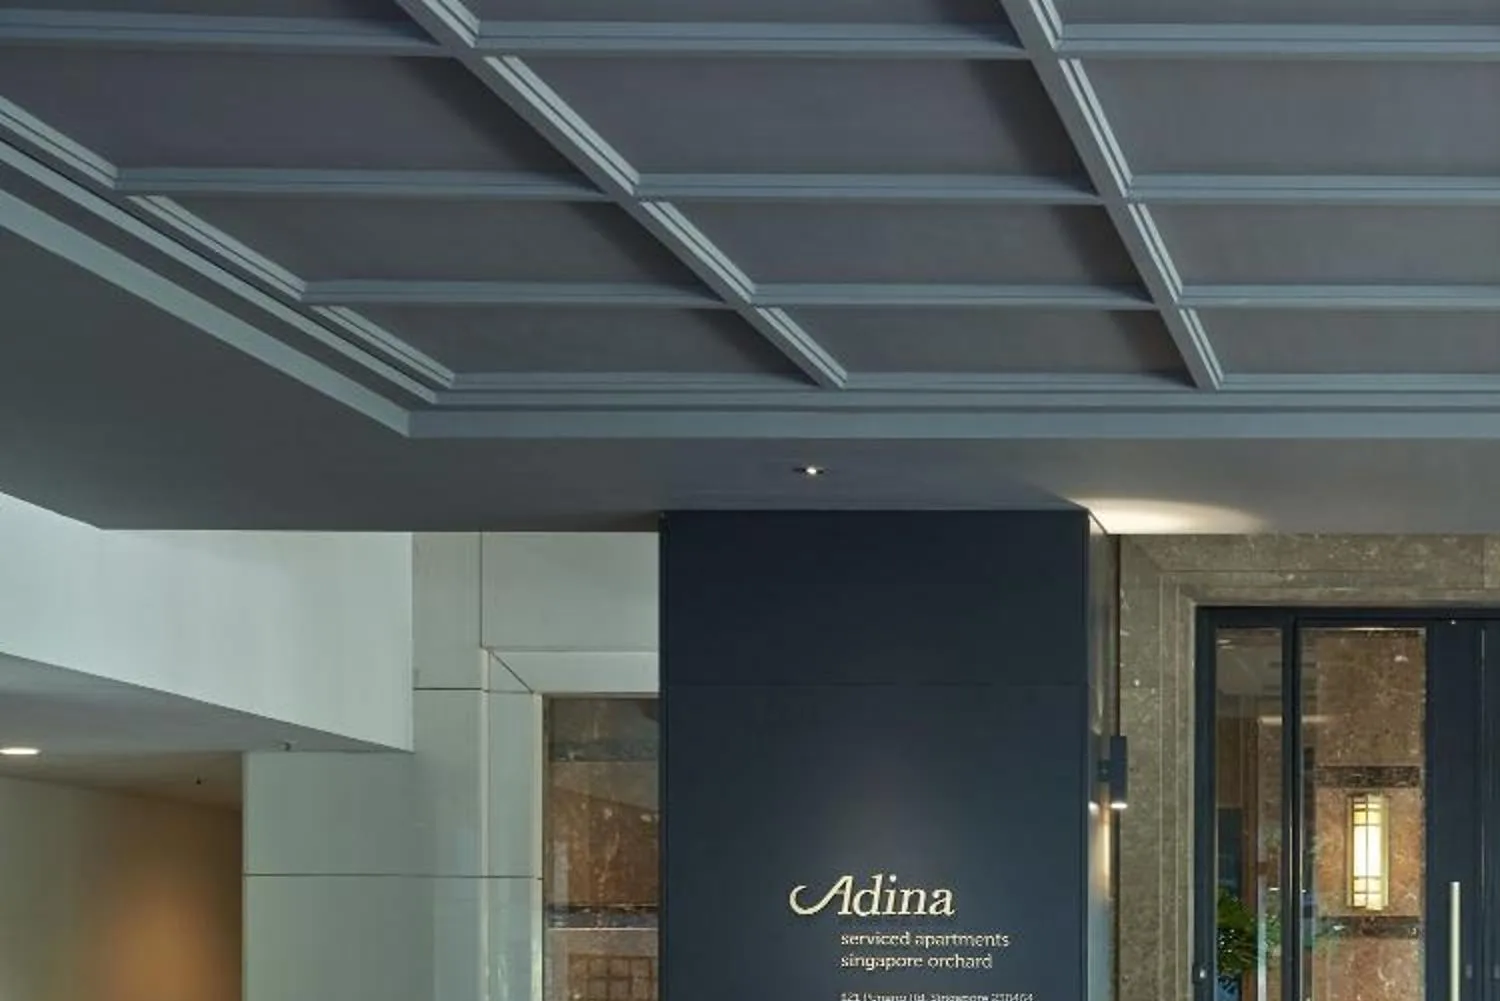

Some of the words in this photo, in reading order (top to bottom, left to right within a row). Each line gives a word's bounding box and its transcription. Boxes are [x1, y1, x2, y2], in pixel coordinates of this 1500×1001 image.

[789, 874, 955, 917] Adina
[840, 931, 910, 945] serviced
[915, 933, 1009, 948] apartments
[840, 954, 923, 971] singapore
[927, 954, 993, 969] orchard
